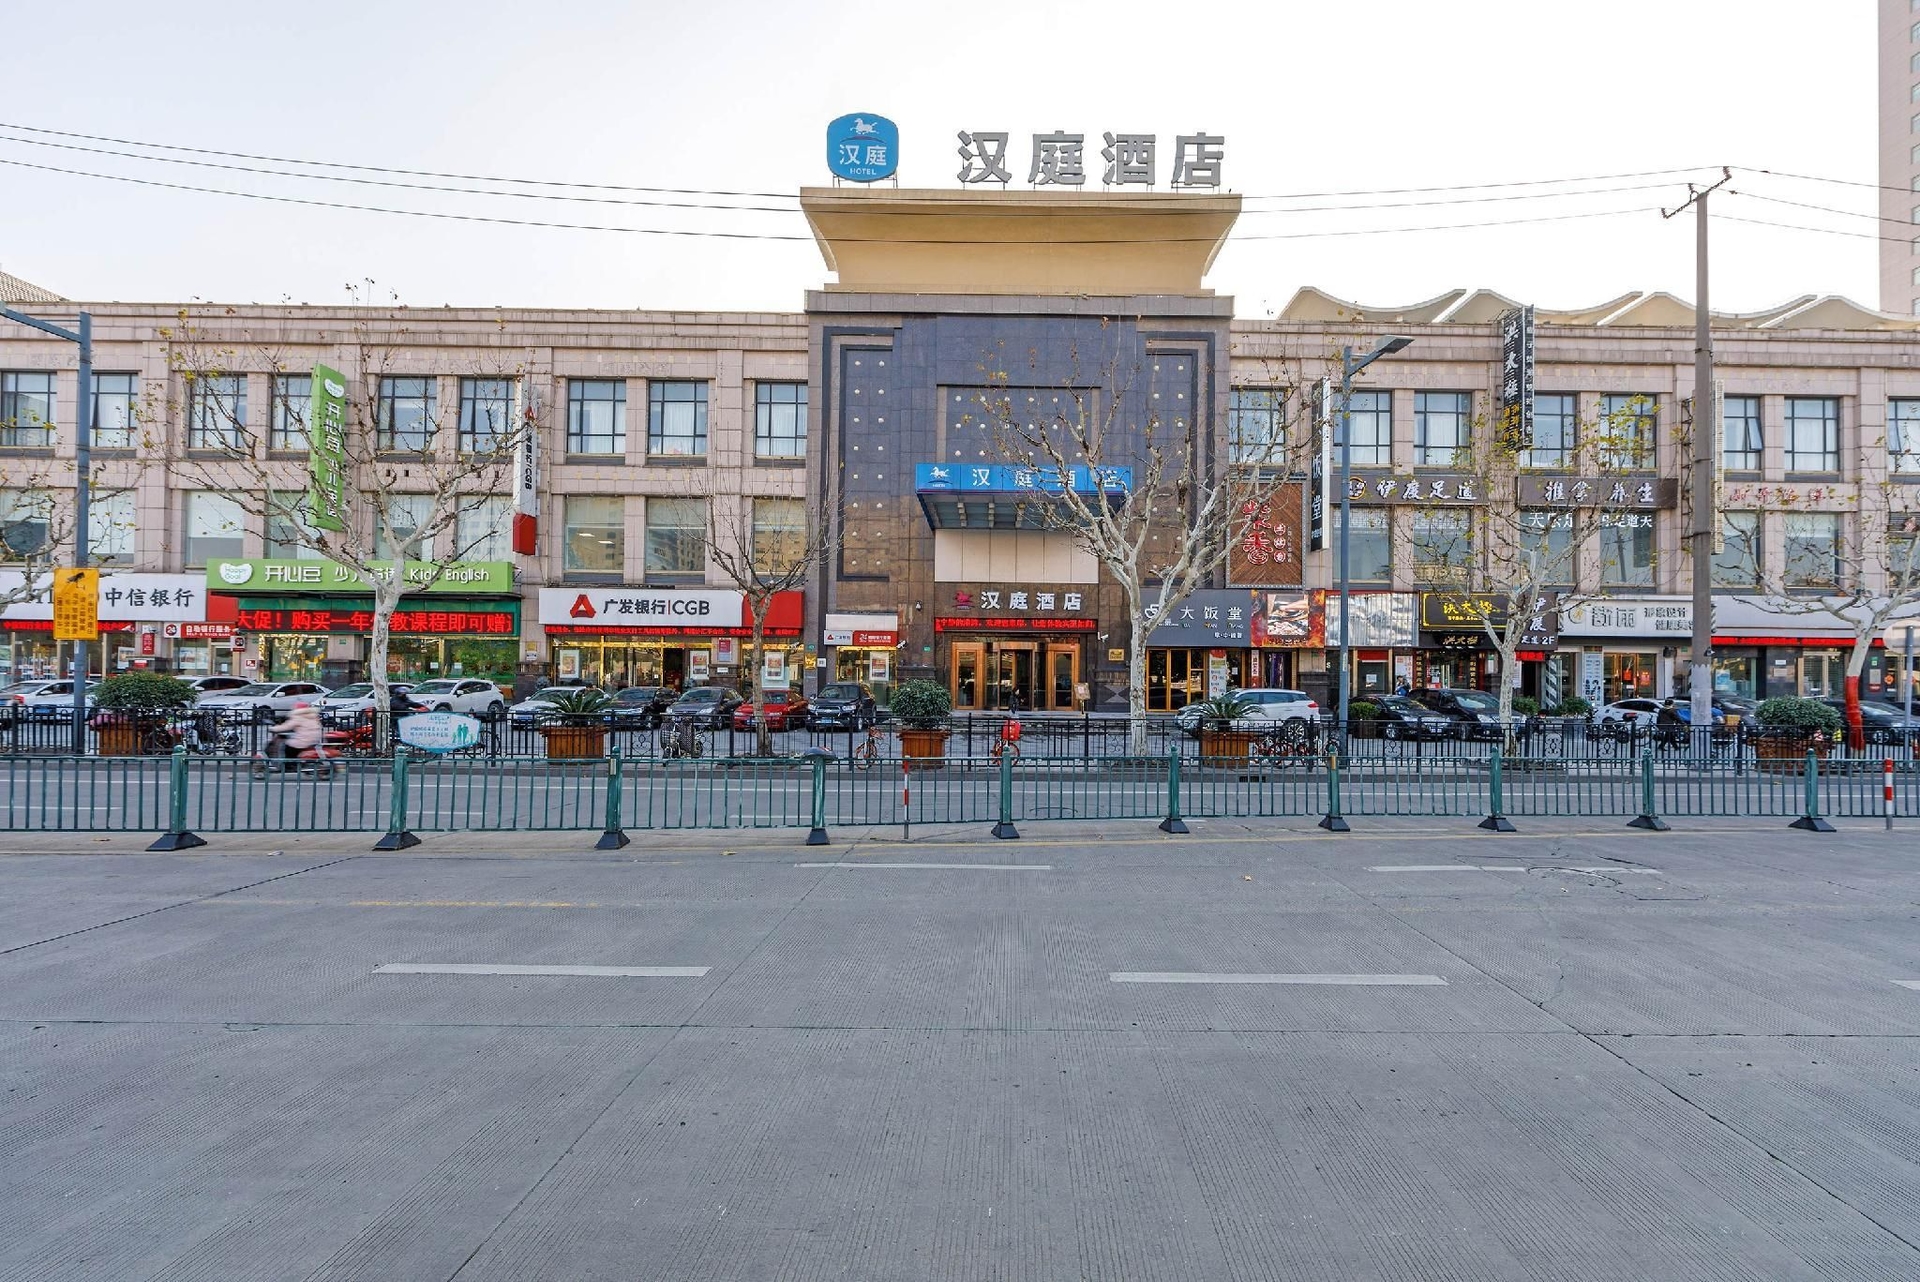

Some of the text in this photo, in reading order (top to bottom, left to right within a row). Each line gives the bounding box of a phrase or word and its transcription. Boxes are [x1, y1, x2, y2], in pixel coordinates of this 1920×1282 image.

[839, 144, 887, 166] 汉庭
[958, 130, 1225, 185] 汉庭酒店
[849, 167, 877, 176] HOTEL
[264, 565, 322, 583] 开心豆
[446, 567, 490, 584] English
[105, 587, 195, 608] 中信银行
[981, 591, 1082, 611] 汉庭酒店
[672, 600, 710, 616] CGB
[1180, 605, 1243, 621] 大饭堂
[1541, 636, 1555, 645] 2F
